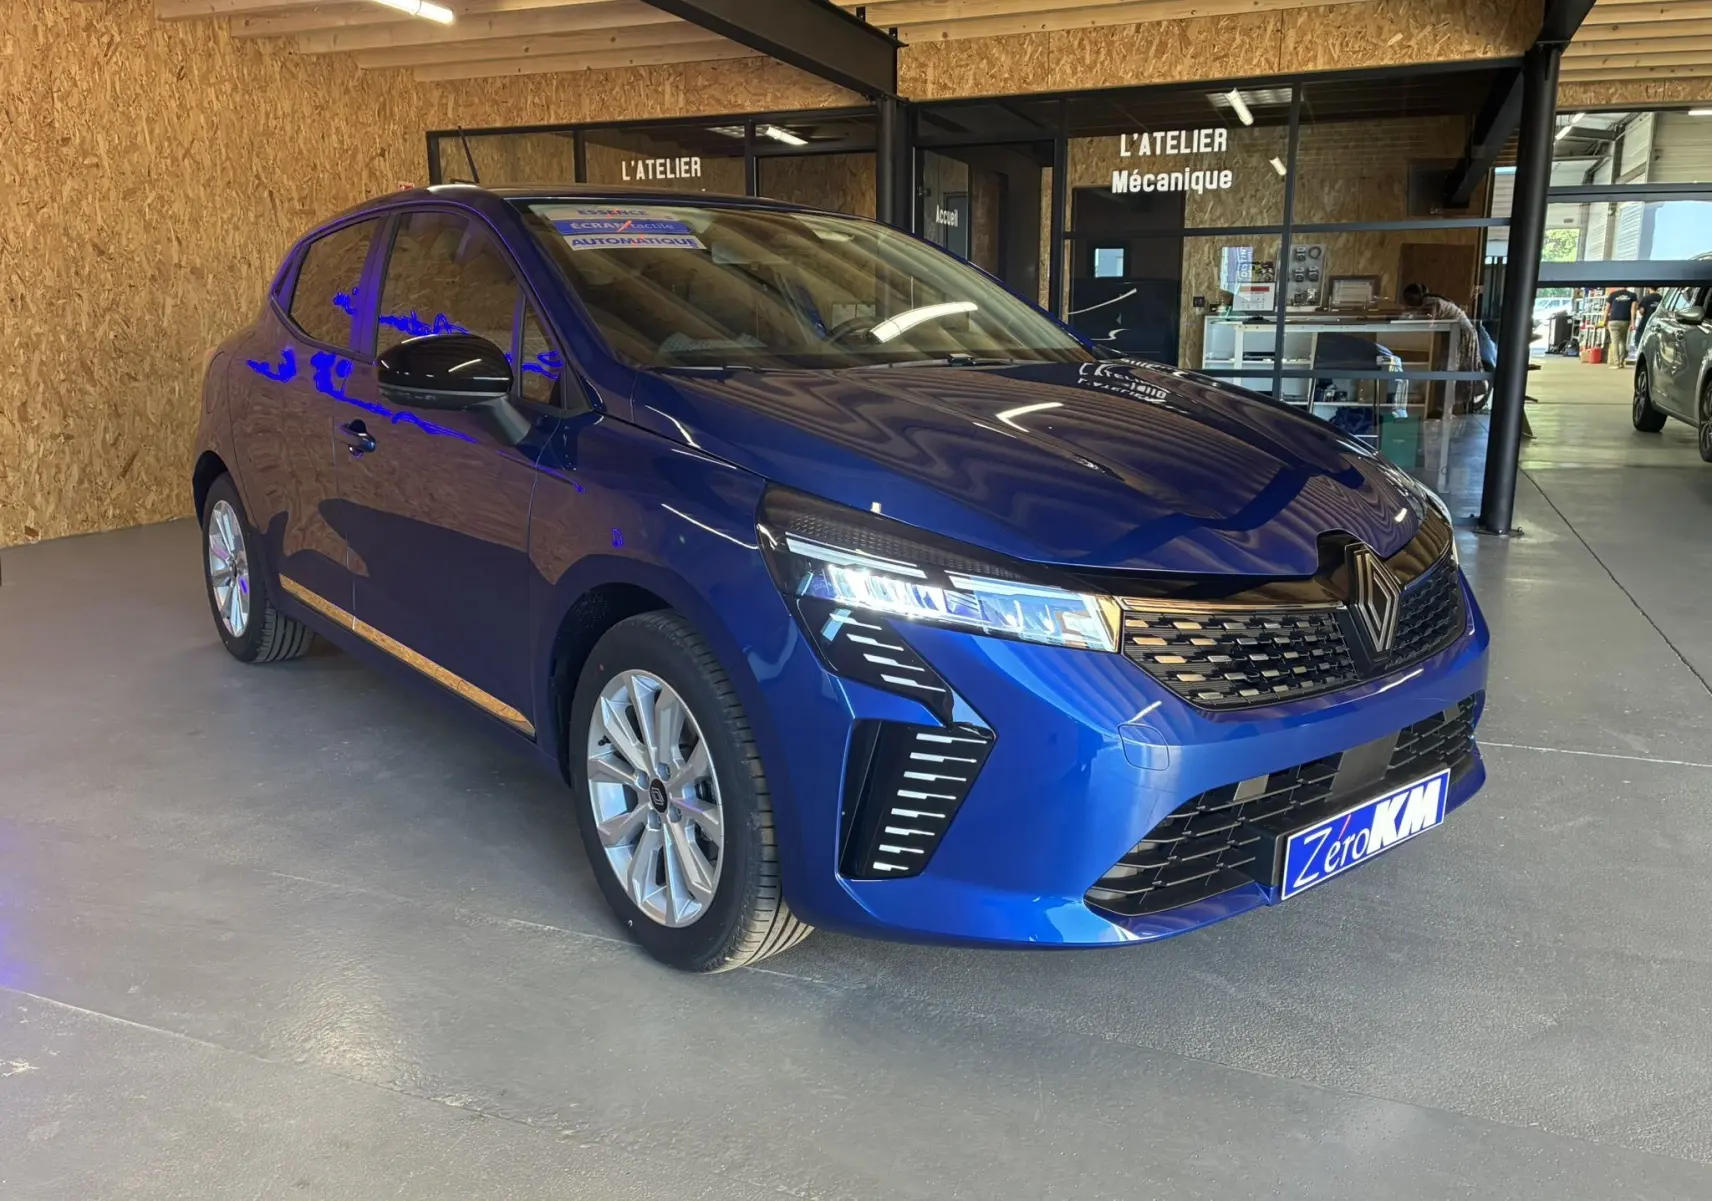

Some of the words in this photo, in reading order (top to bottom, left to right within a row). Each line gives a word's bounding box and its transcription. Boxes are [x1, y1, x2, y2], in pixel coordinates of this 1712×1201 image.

[1120, 128, 1227, 157] L'ATELIER
[621, 157, 701, 180] L'ATELIER
[1111, 167, 1232, 194] Mécanique
[935, 204, 958, 227] Accueil
[571, 236, 698, 248] AUTOMATIQUE
